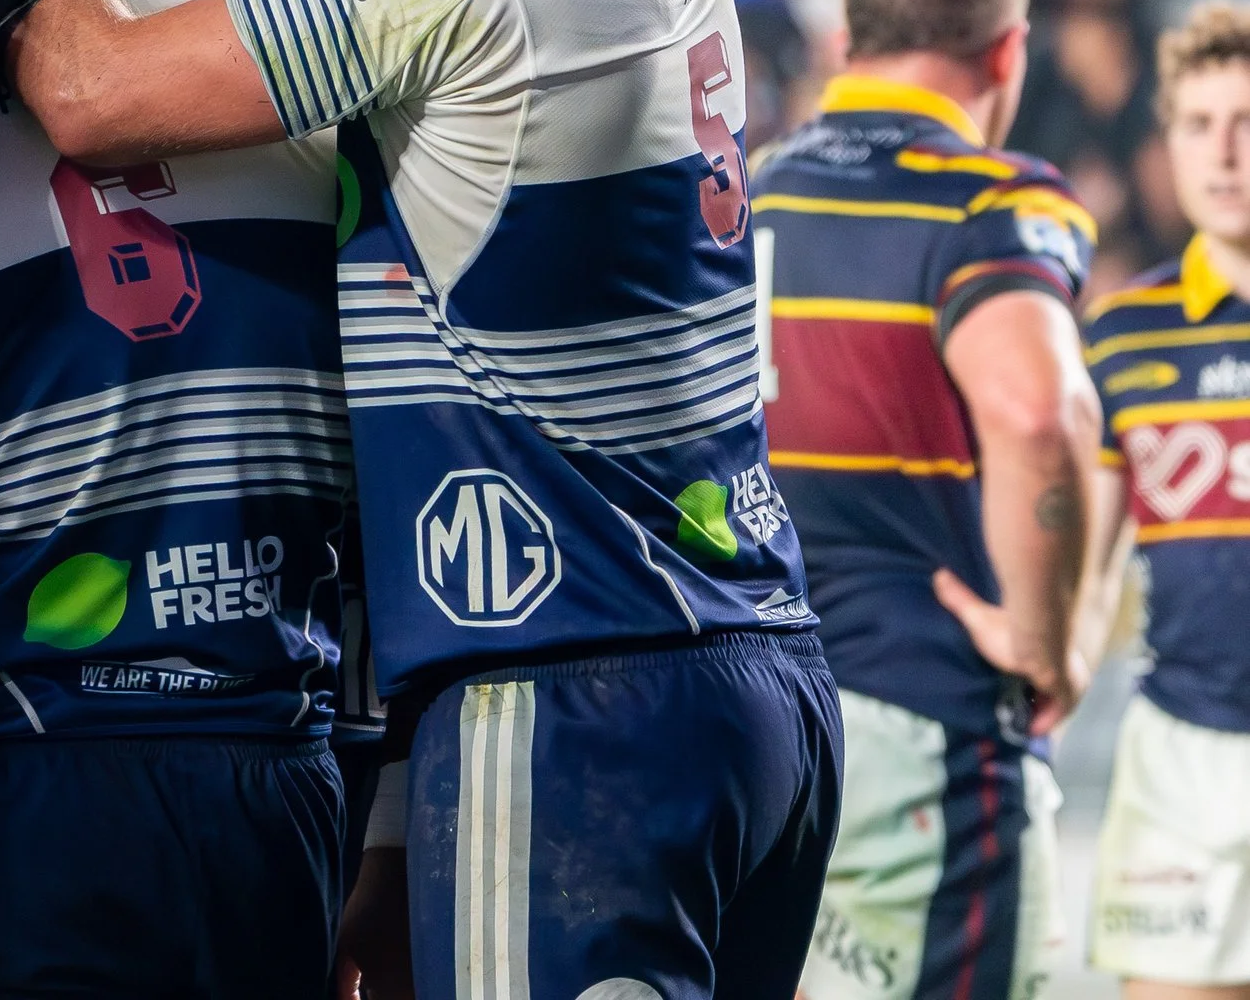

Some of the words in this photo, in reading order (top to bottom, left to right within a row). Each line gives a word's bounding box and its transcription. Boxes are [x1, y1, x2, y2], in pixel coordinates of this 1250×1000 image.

[687, 31, 748, 250] 5
[49, 156, 202, 343] 6
[145, 536, 284, 589] HELLO
[430, 483, 546, 612] MG
[150, 575, 282, 630] FRESH
[81, 665, 113, 689] WE
[113, 667, 154, 690] ARE
[158, 672, 195, 692] THE
